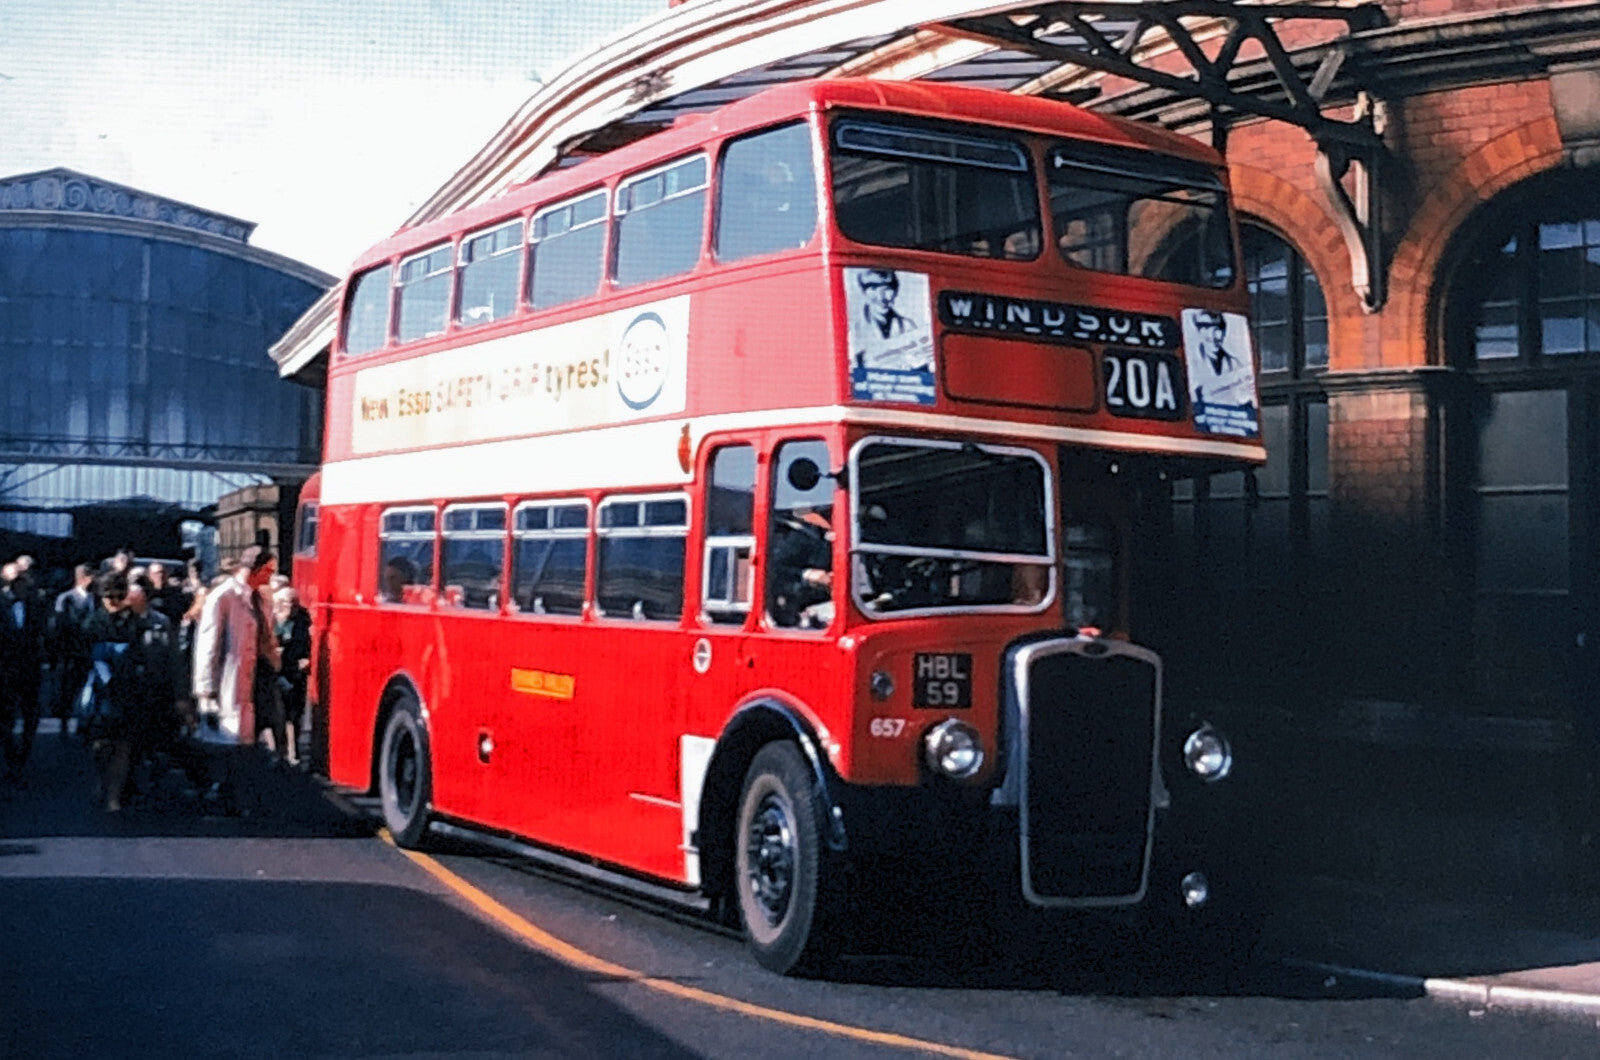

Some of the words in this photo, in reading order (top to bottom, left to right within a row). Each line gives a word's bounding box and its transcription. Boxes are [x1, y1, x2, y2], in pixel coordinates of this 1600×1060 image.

[950, 298, 1165, 338] WINDSOR
[1104, 357, 1176, 410] 20A
[918, 656, 966, 679] HBL
[926, 682, 958, 704] 59
[870, 718, 905, 737] 657
